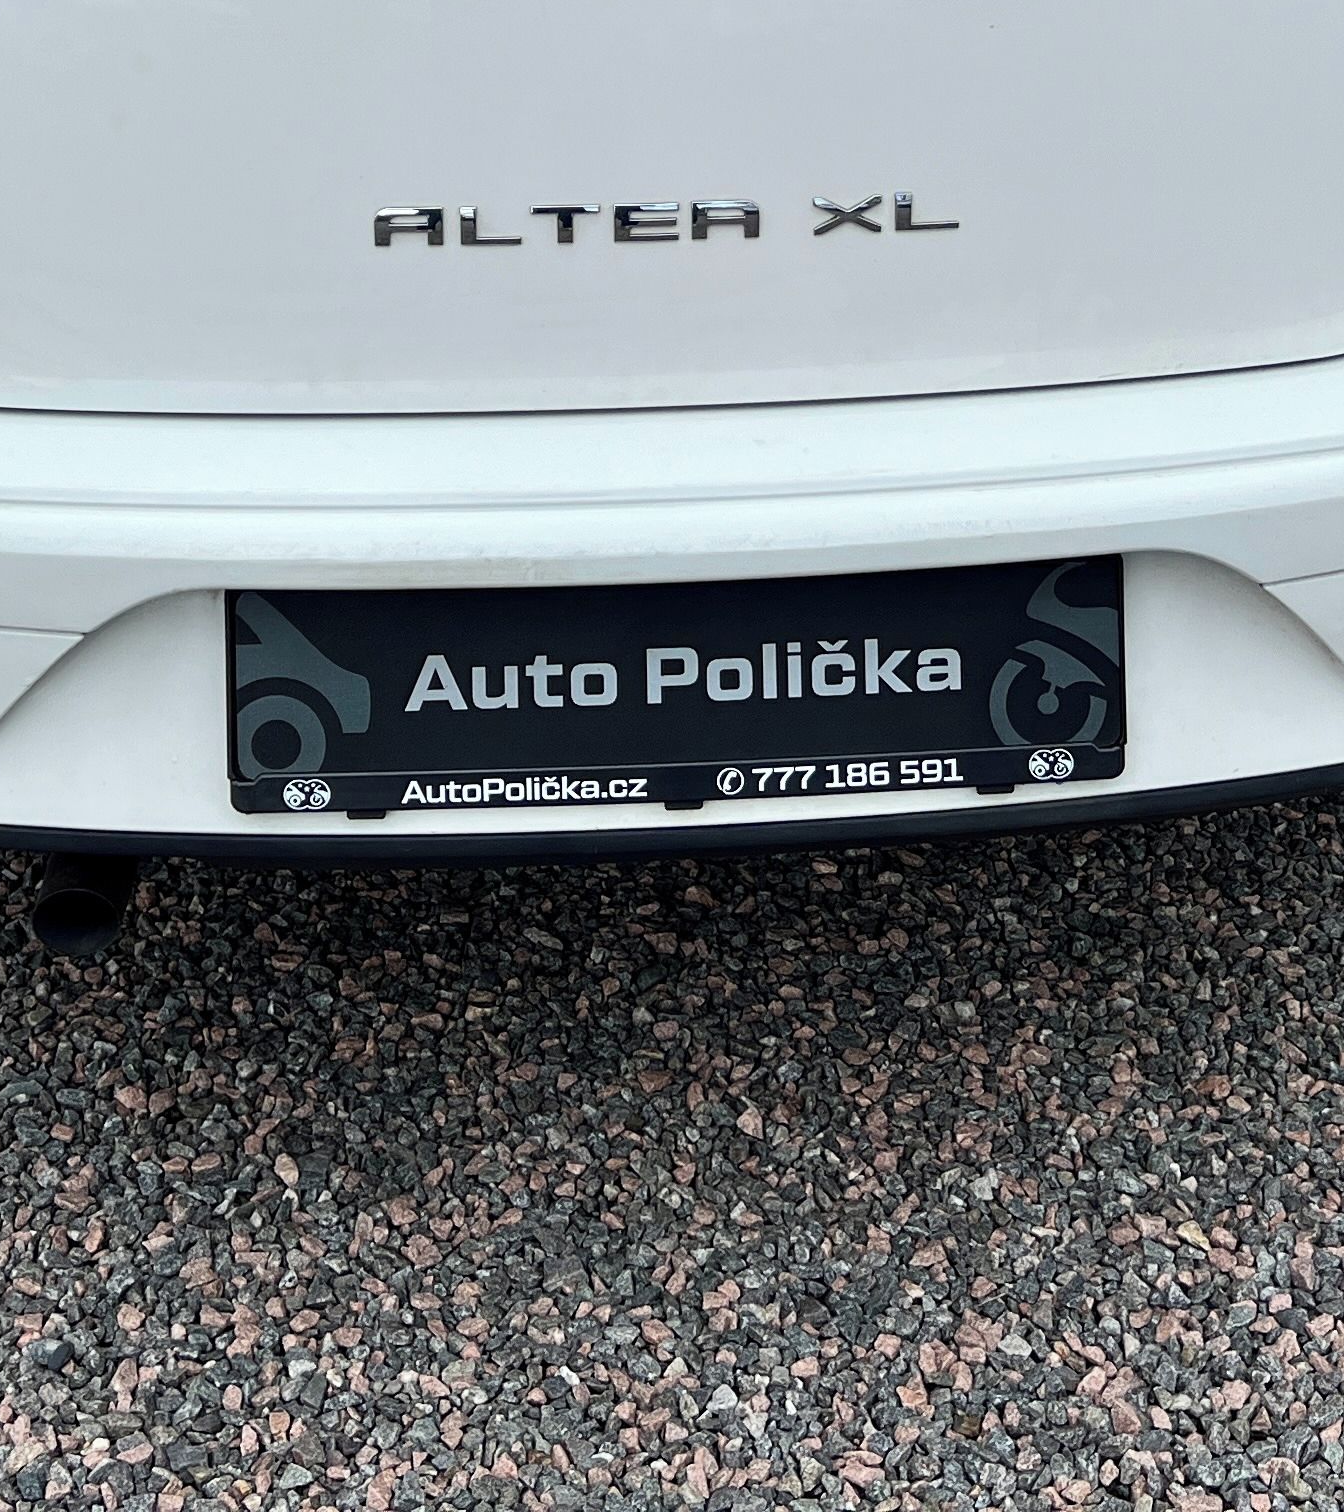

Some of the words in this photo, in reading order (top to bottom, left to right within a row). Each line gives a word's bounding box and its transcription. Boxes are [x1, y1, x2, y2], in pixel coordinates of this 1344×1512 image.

[373, 199, 761, 247] ALTEA
[811, 191, 960, 237] XL
[404, 653, 618, 712] Auto
[645, 637, 963, 705] Polička
[400, 775, 648, 805] AutoPolička.cz
[751, 765, 817, 792] 777
[824, 761, 891, 789] 186
[899, 757, 964, 785] 591
